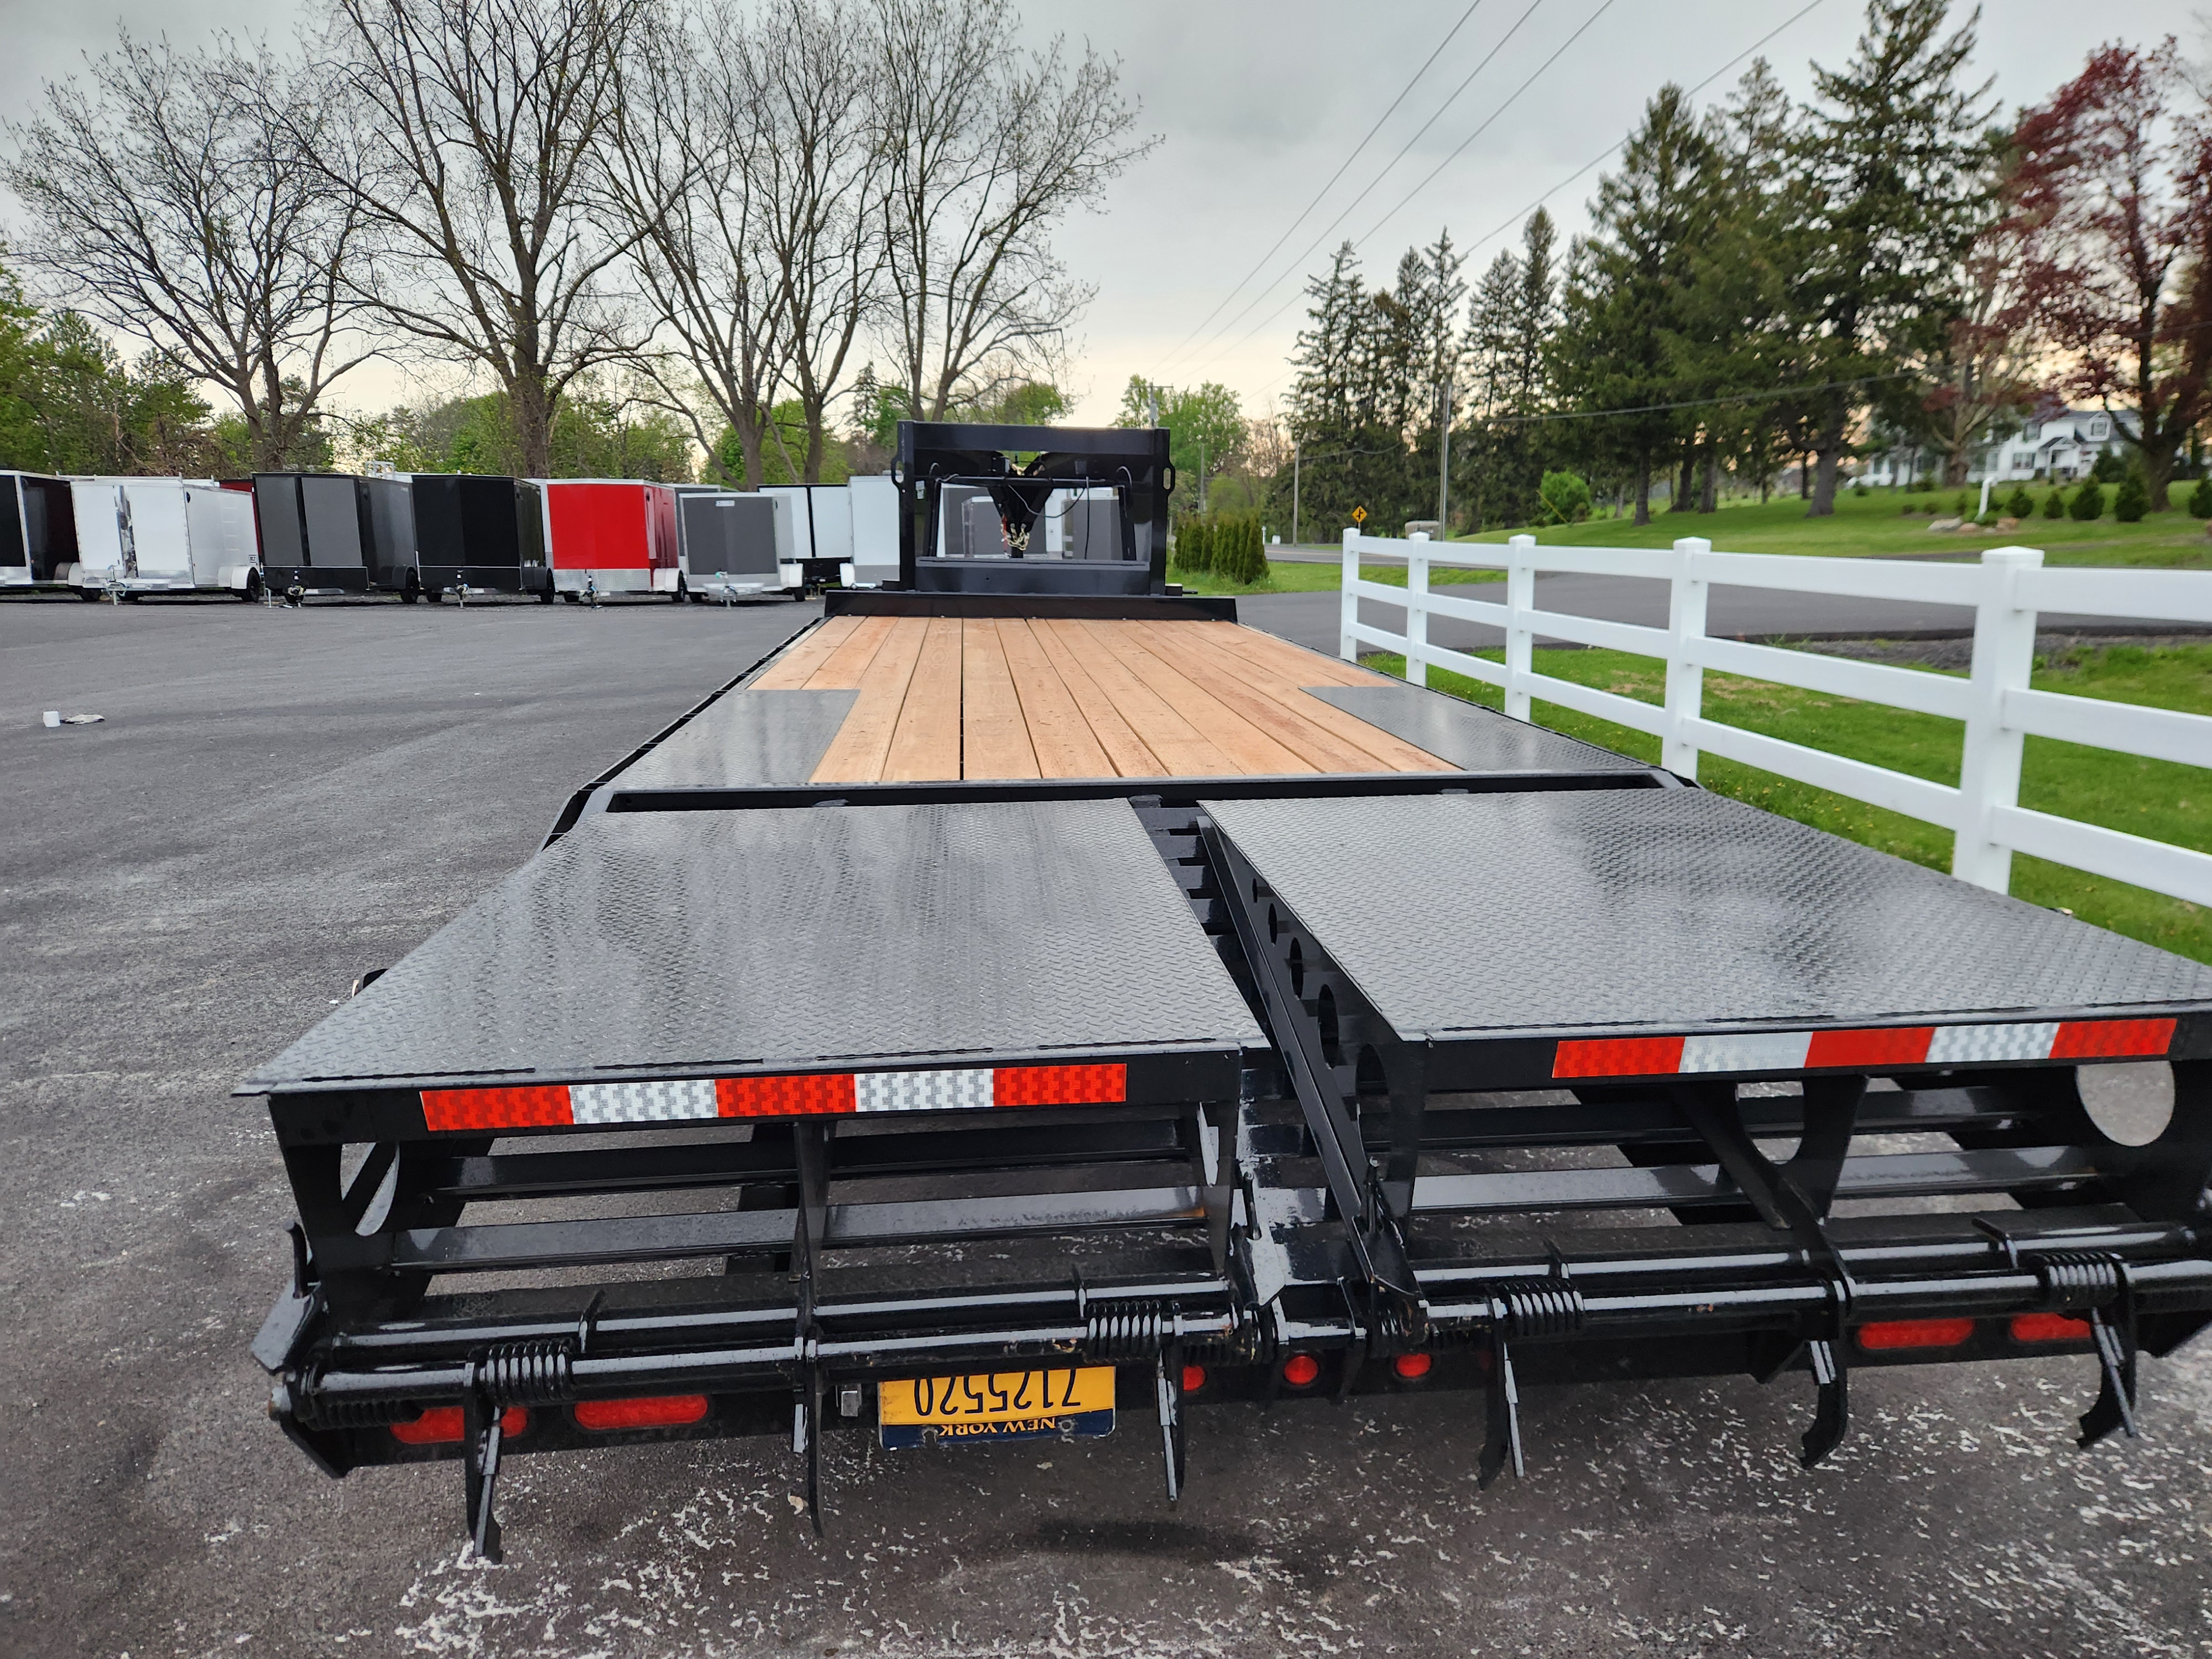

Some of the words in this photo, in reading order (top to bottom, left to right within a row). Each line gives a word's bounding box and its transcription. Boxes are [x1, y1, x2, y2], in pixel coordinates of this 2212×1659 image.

[914, 1369, 1081, 1416] 7125520
[939, 1422, 998, 1436] YORK
[1003, 1417, 1056, 1433] NEW
